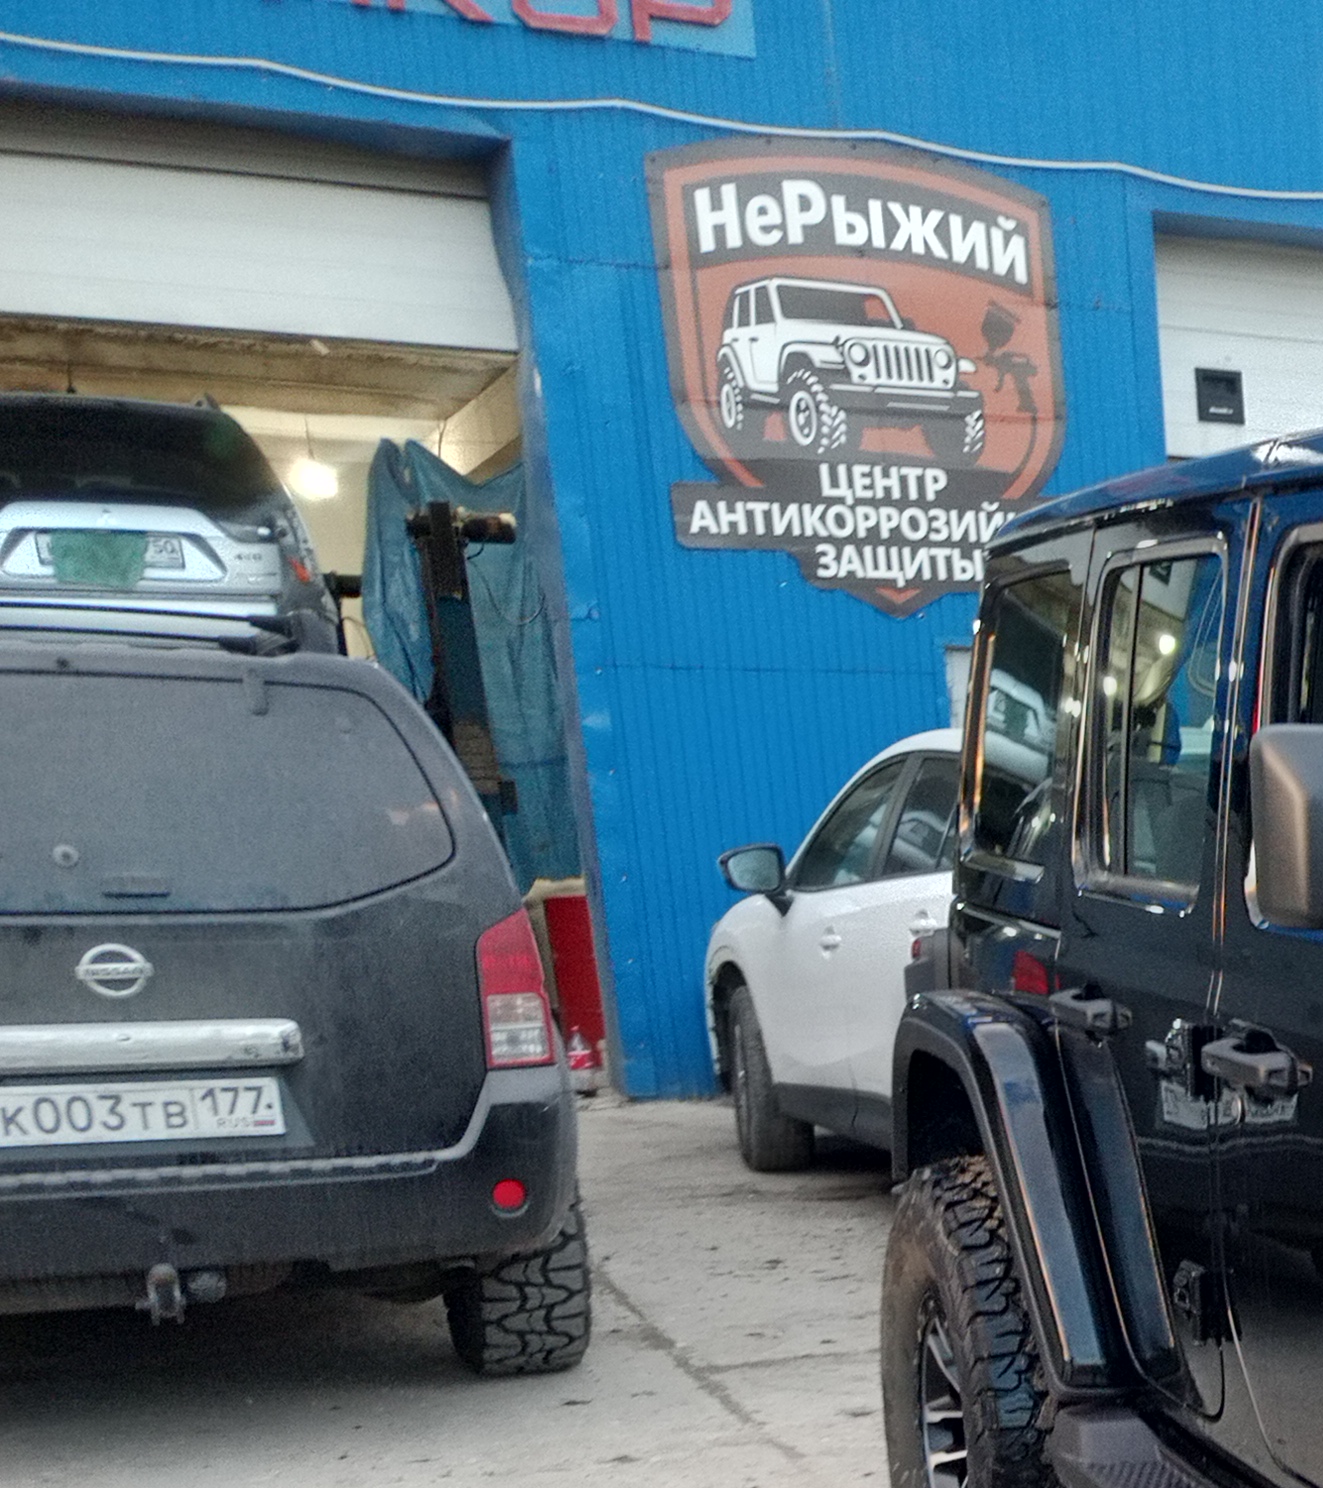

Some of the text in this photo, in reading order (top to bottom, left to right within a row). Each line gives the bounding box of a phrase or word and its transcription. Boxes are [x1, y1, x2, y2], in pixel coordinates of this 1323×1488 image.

[693, 178, 1030, 286] НеРыжий
[818, 462, 949, 505] ЦЕНТР
[689, 501, 1018, 544] АНТИКОРРОЗИЙ
[814, 543, 988, 588] ЗАЩИТЫ
[1, 1085, 263, 1137] К003ТВ 177
